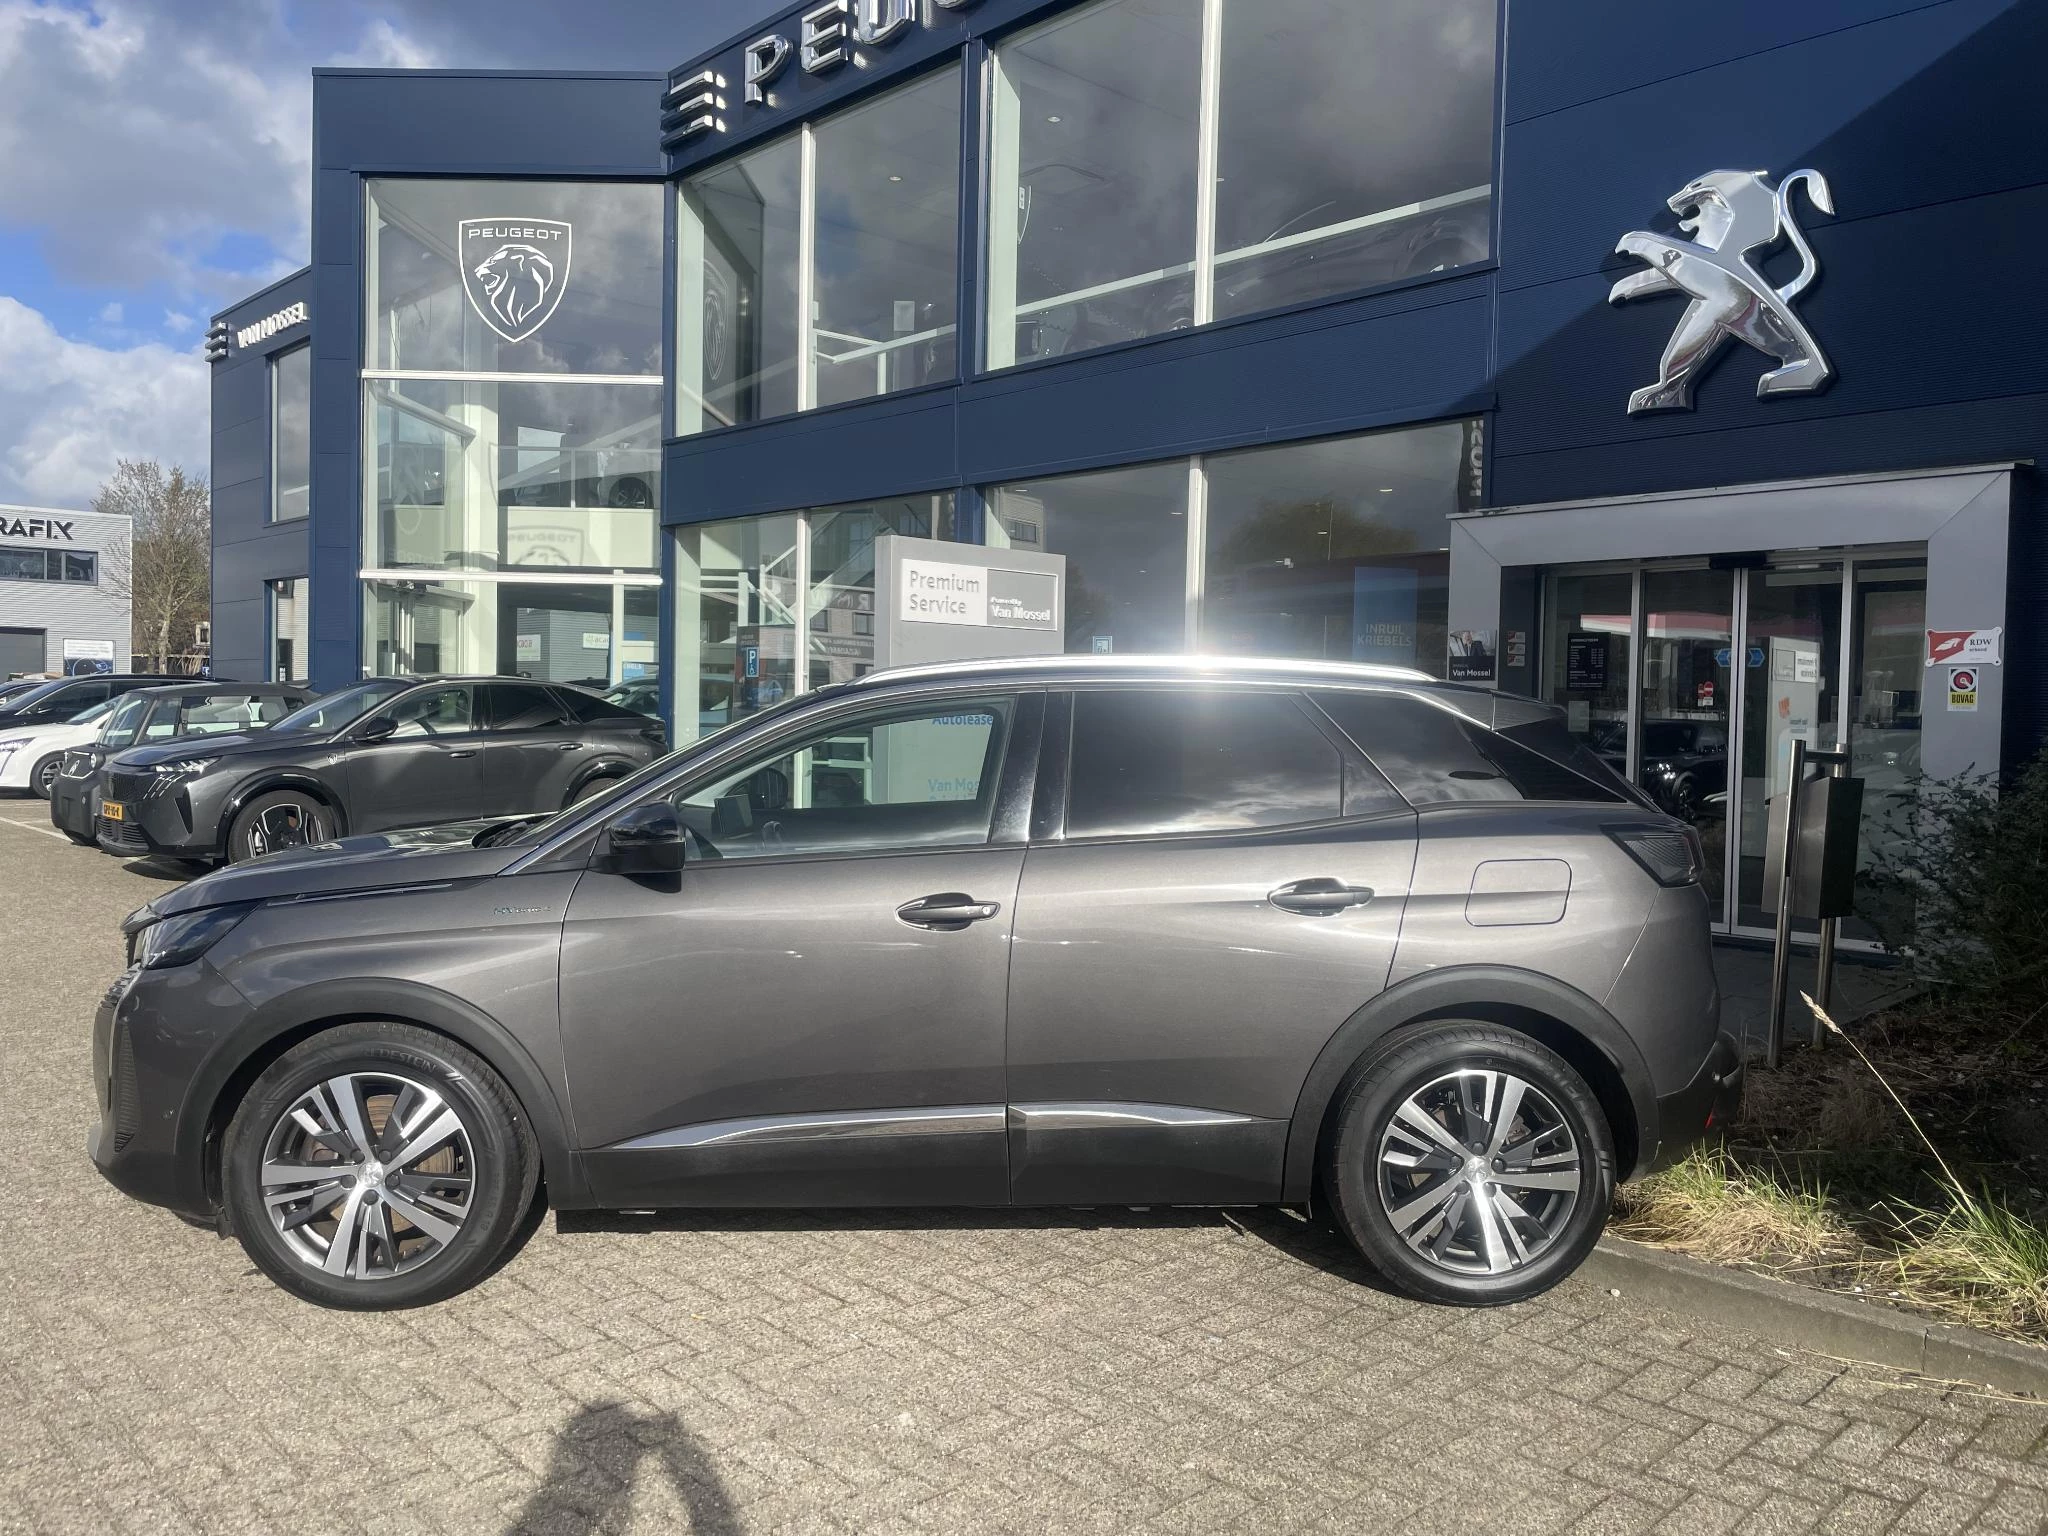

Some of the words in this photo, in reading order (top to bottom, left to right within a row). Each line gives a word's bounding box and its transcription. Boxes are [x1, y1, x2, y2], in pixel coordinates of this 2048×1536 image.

[745, 0, 980, 104] PEU
[468, 227, 562, 240] PEUGEOT
[237, 322, 261, 348] VAN
[260, 301, 309, 339] MOSSEL
[909, 570, 980, 593] Premium
[909, 594, 967, 614] Service
[991, 605, 1012, 618] Van
[1012, 606, 1051, 621] Mossel
[1366, 623, 1405, 635] INRUIL
[1358, 635, 1413, 647] KRIEBELS
[1970, 638, 1992, 646] RDW
[1452, 669, 1465, 677] Van
[1466, 668, 1491, 677] Mossel
[1951, 694, 1974, 704] BOVAG
[932, 713, 993, 726] Autolease
